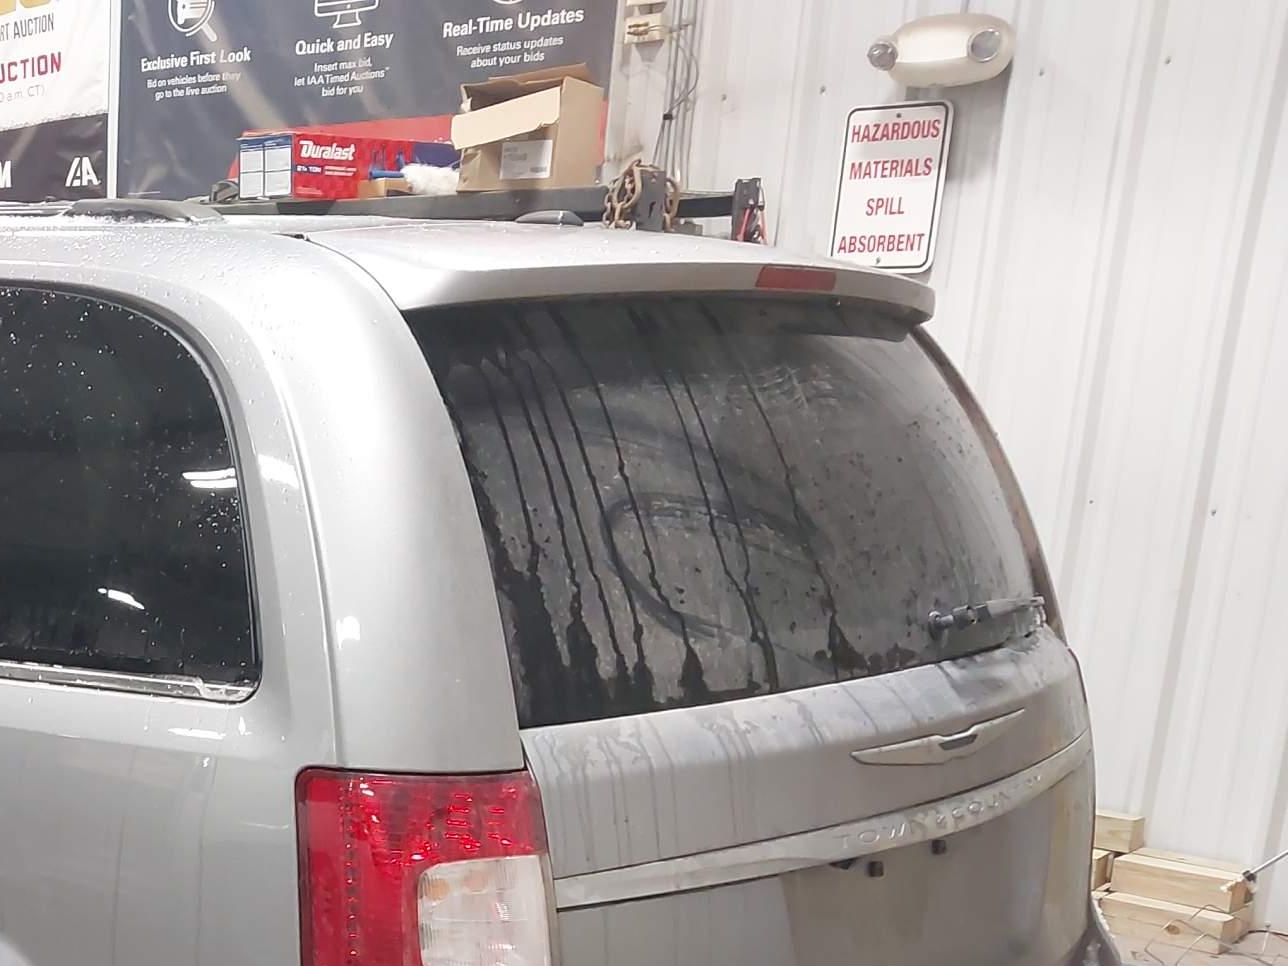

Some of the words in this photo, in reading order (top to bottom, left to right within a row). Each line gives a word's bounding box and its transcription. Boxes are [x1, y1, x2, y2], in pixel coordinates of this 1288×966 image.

[13, 13, 55, 39] AUCTION
[443, 16, 513, 38] Real-Time
[517, 8, 585, 32] Updates
[295, 37, 334, 56] Quick
[336, 33, 361, 52] and
[363, 31, 394, 49] Easy
[456, 43, 491, 56] Receive
[492, 40, 522, 53] status
[524, 36, 564, 51] updates
[140, 53, 188, 73] Exclusive
[189, 50, 217, 67] First
[219, 46, 252, 64] Look
[314, 61, 338, 73] Insert
[471, 55, 498, 69] about
[498, 54, 521, 68] your
[523, 51, 545, 63] bids
[158, 78, 167, 88] on
[167, 74, 197, 86] vehicles
[197, 71, 221, 83] before
[222, 71, 242, 82] they
[294, 76, 305, 87] let
[307, 74, 324, 86] IAA
[325, 71, 350, 84] Timed
[155, 90, 165, 102] go
[165, 89, 172, 98] to
[172, 87, 185, 97] the
[185, 86, 200, 96] live
[200, 83, 228, 96] auction
[321, 86, 335, 97] bid
[336, 85, 347, 96] for
[348, 85, 364, 97] you
[851, 119, 941, 143] HAZARDOUS
[298, 139, 356, 161] Duralast
[849, 157, 934, 180] MATERIALS
[865, 196, 905, 217] SPILL
[837, 233, 926, 254] ABSORBENT
